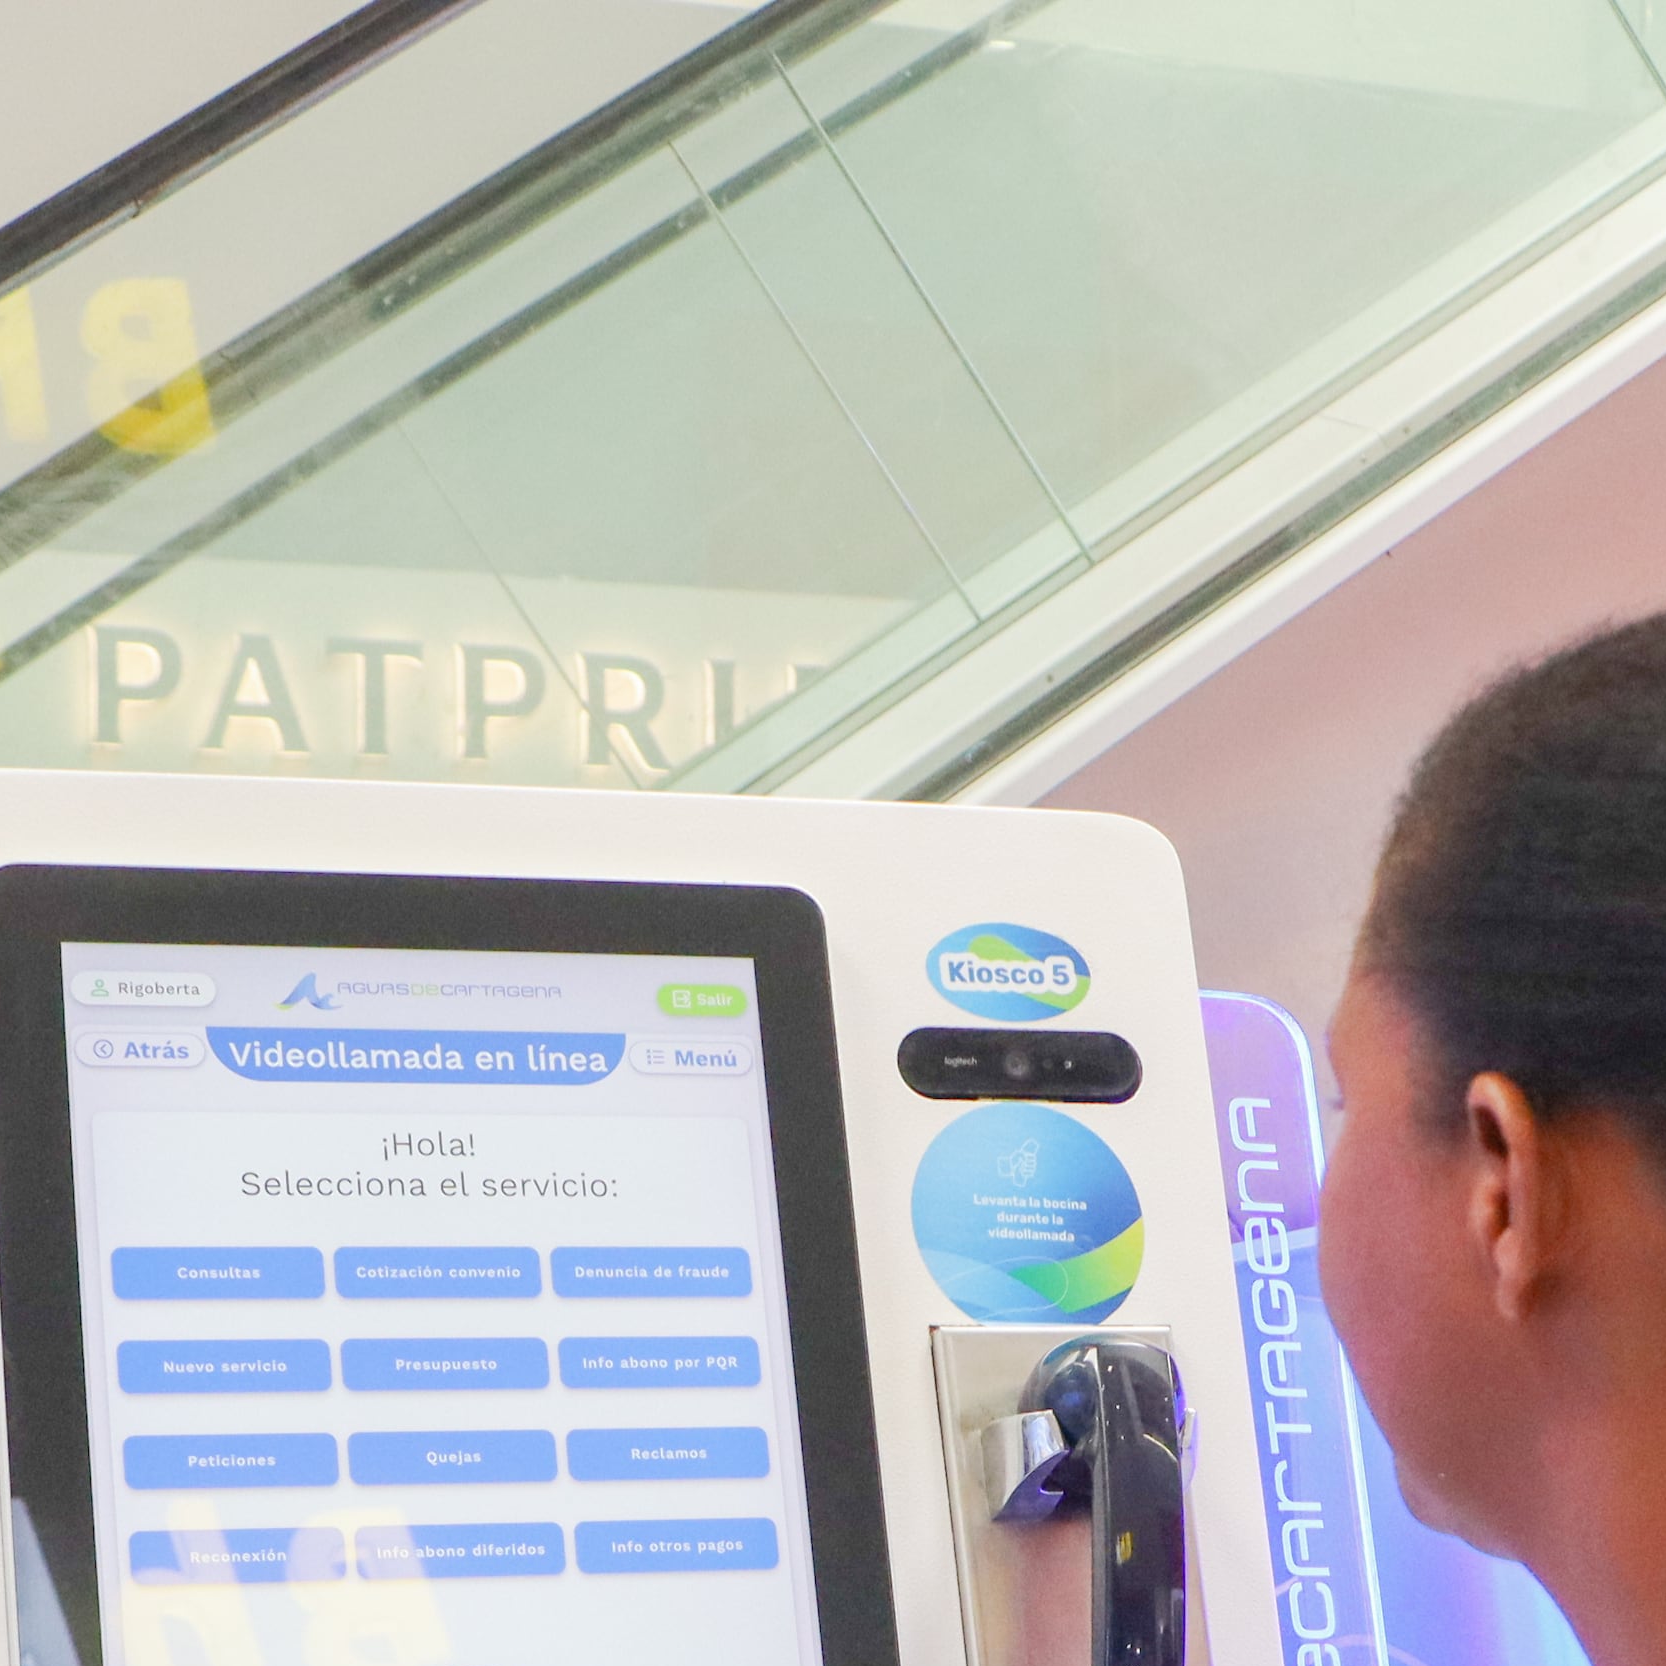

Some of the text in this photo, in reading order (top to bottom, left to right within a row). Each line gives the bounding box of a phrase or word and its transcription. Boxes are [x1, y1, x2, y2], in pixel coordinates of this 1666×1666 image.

[947, 959, 1071, 986] Kiosco 5
[117, 981, 201, 998] Rigoberta
[696, 992, 735, 1007] Salir
[123, 1040, 191, 1060] Atrás
[228, 1040, 609, 1073] Videollamada en línea
[674, 1049, 738, 1068] Menú
[382, 1130, 477, 1161] ¡Hola!
[240, 1169, 620, 1198] Selecciona el servicio:
[972, 1193, 1088, 1211] Levanta la bocina
[996, 1210, 1064, 1226] durante la
[987, 1227, 1076, 1243] videollamada
[176, 1265, 262, 1280] Consultas
[355, 1265, 522, 1280] Cotización convenio
[573, 1264, 731, 1279] Denuncia de fraude
[162, 1358, 288, 1374] Nuevo servicio
[394, 1357, 498, 1375] Presupuesto
[582, 1355, 739, 1372] Info abono por PQR
[186, 1454, 277, 1468] Peticiones
[425, 1450, 482, 1466] Quejas
[629, 1447, 708, 1461] Reclamos
[376, 1542, 547, 1560] Info abono diferidos
[611, 1538, 744, 1555] Info otros pagos
[189, 1548, 288, 1564] Reconexión
